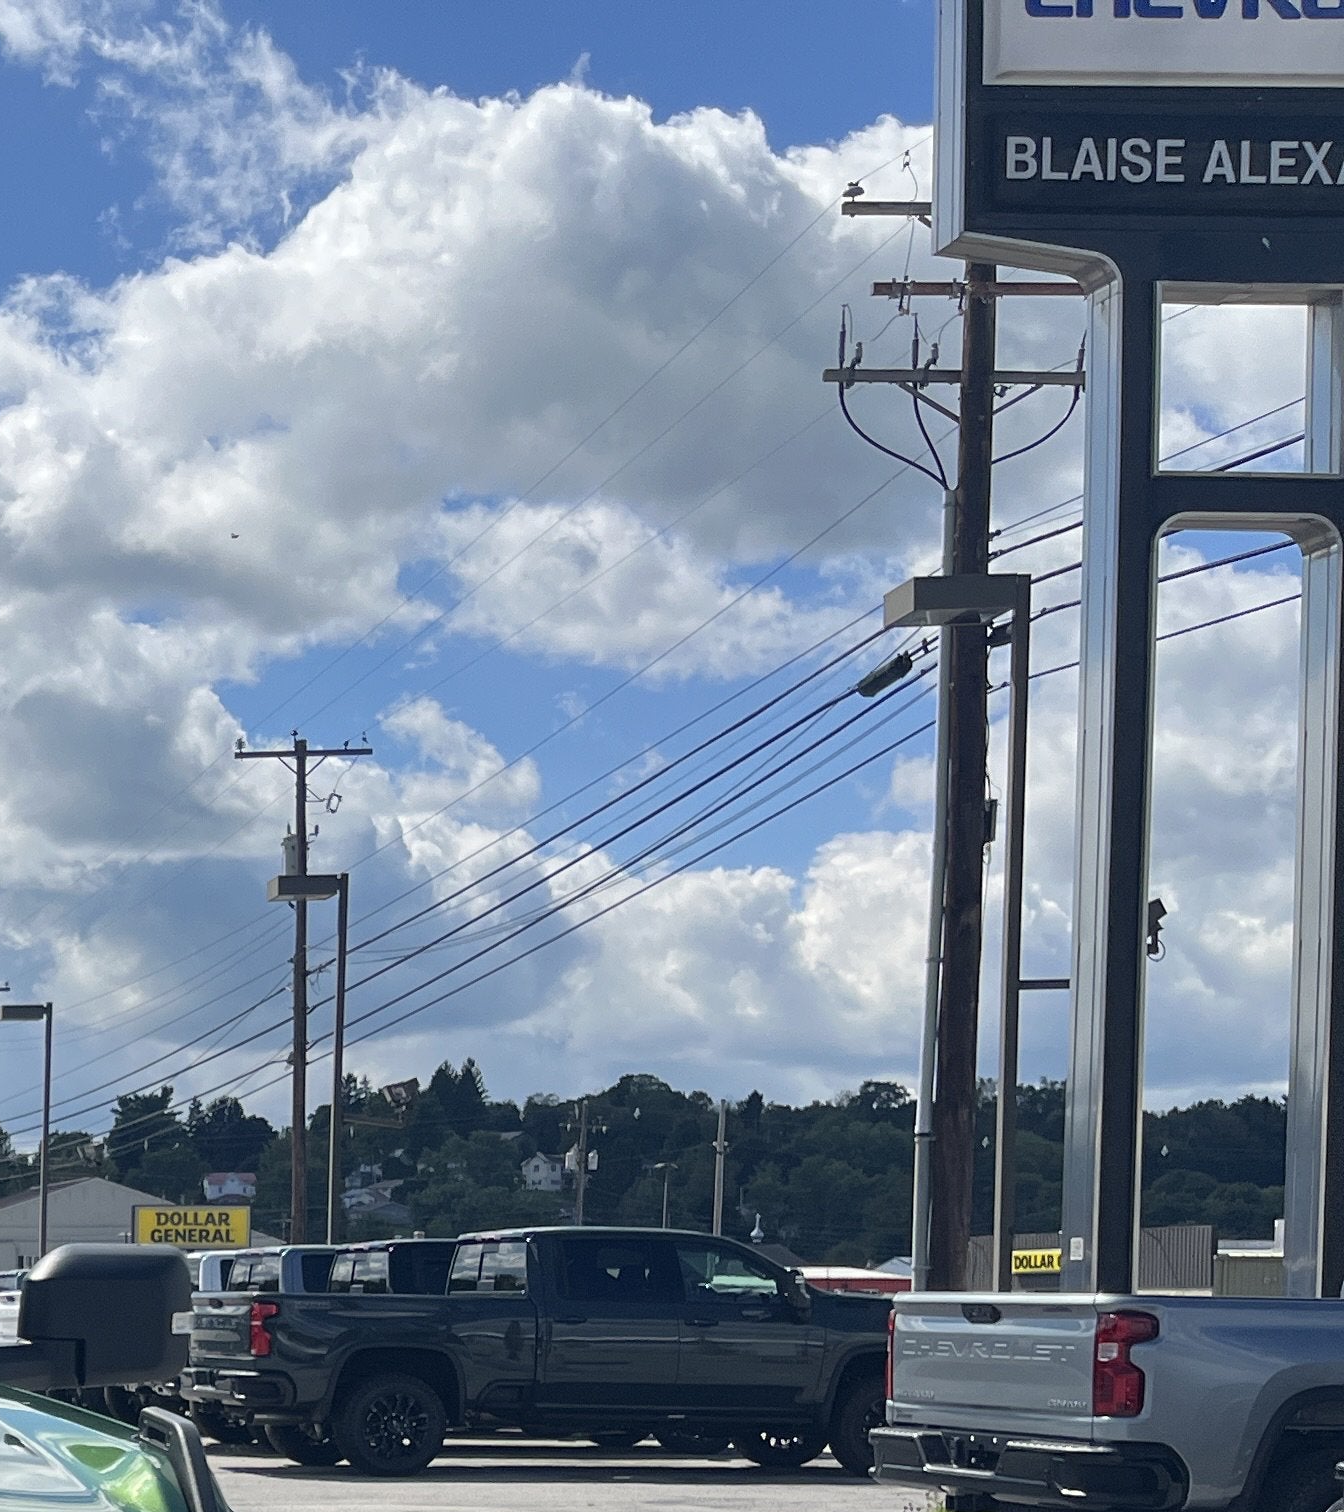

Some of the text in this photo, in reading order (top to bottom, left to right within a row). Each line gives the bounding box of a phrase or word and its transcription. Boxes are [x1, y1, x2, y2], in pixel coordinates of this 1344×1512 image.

[1005, 136, 1186, 184] BLAISE
[155, 1211, 231, 1226] DOLLAR
[150, 1228, 235, 1243] GENERAL
[1014, 1255, 1054, 1269] DOLLAR
[901, 1339, 1076, 1363] CHEVROLET
